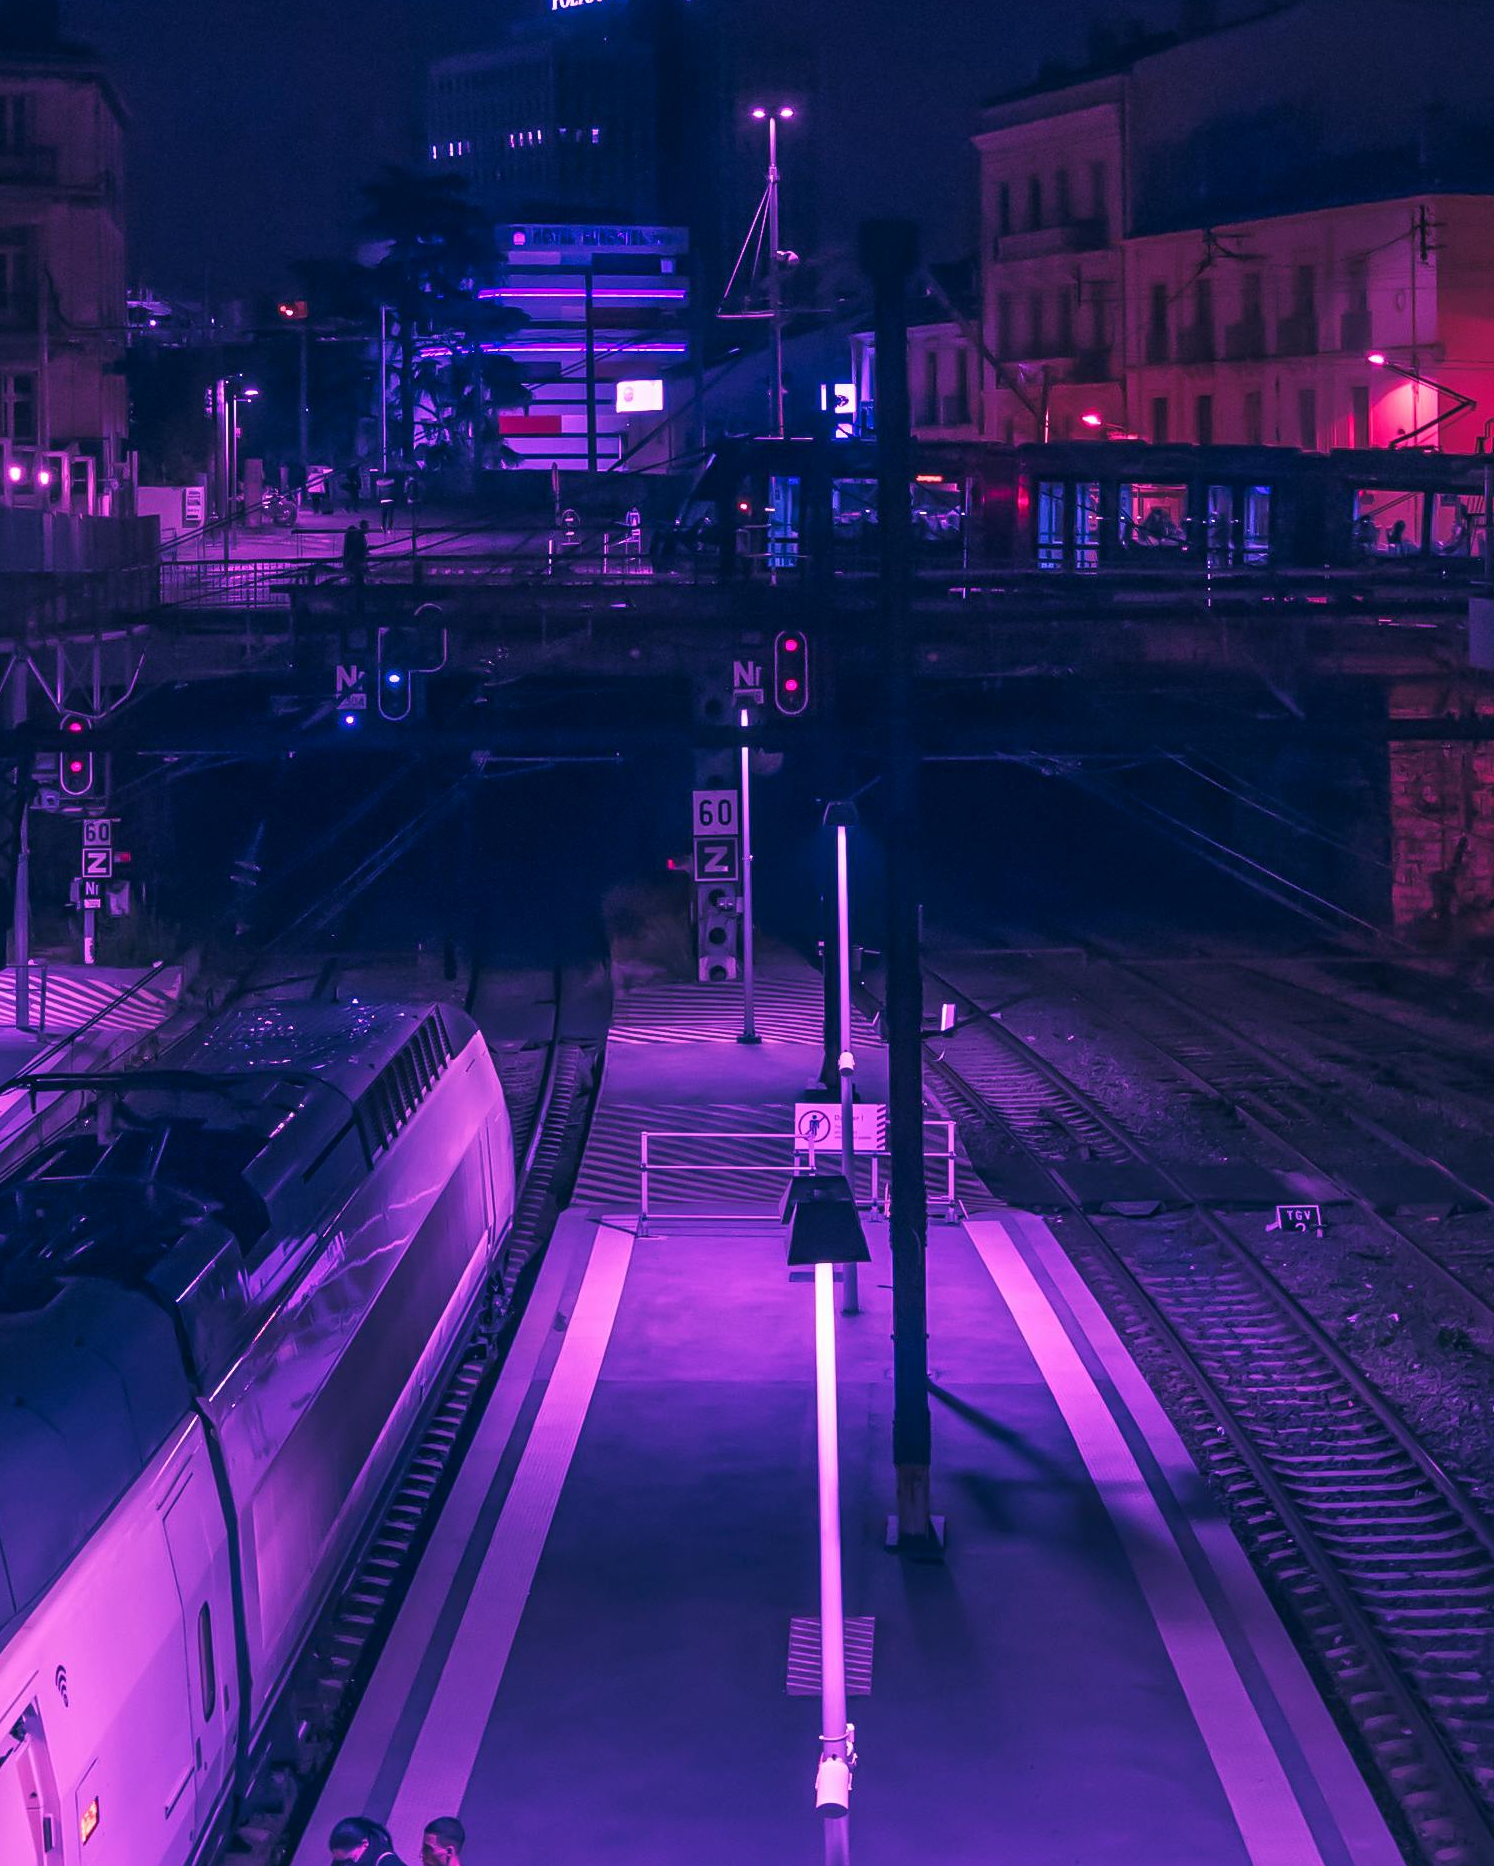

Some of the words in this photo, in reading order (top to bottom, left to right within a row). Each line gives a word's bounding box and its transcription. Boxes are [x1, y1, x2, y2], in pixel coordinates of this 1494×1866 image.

[699, 799, 732, 826] 60
[86, 823, 109, 842] 60
[87, 852, 108, 874] Z
[704, 845, 730, 873] Z
